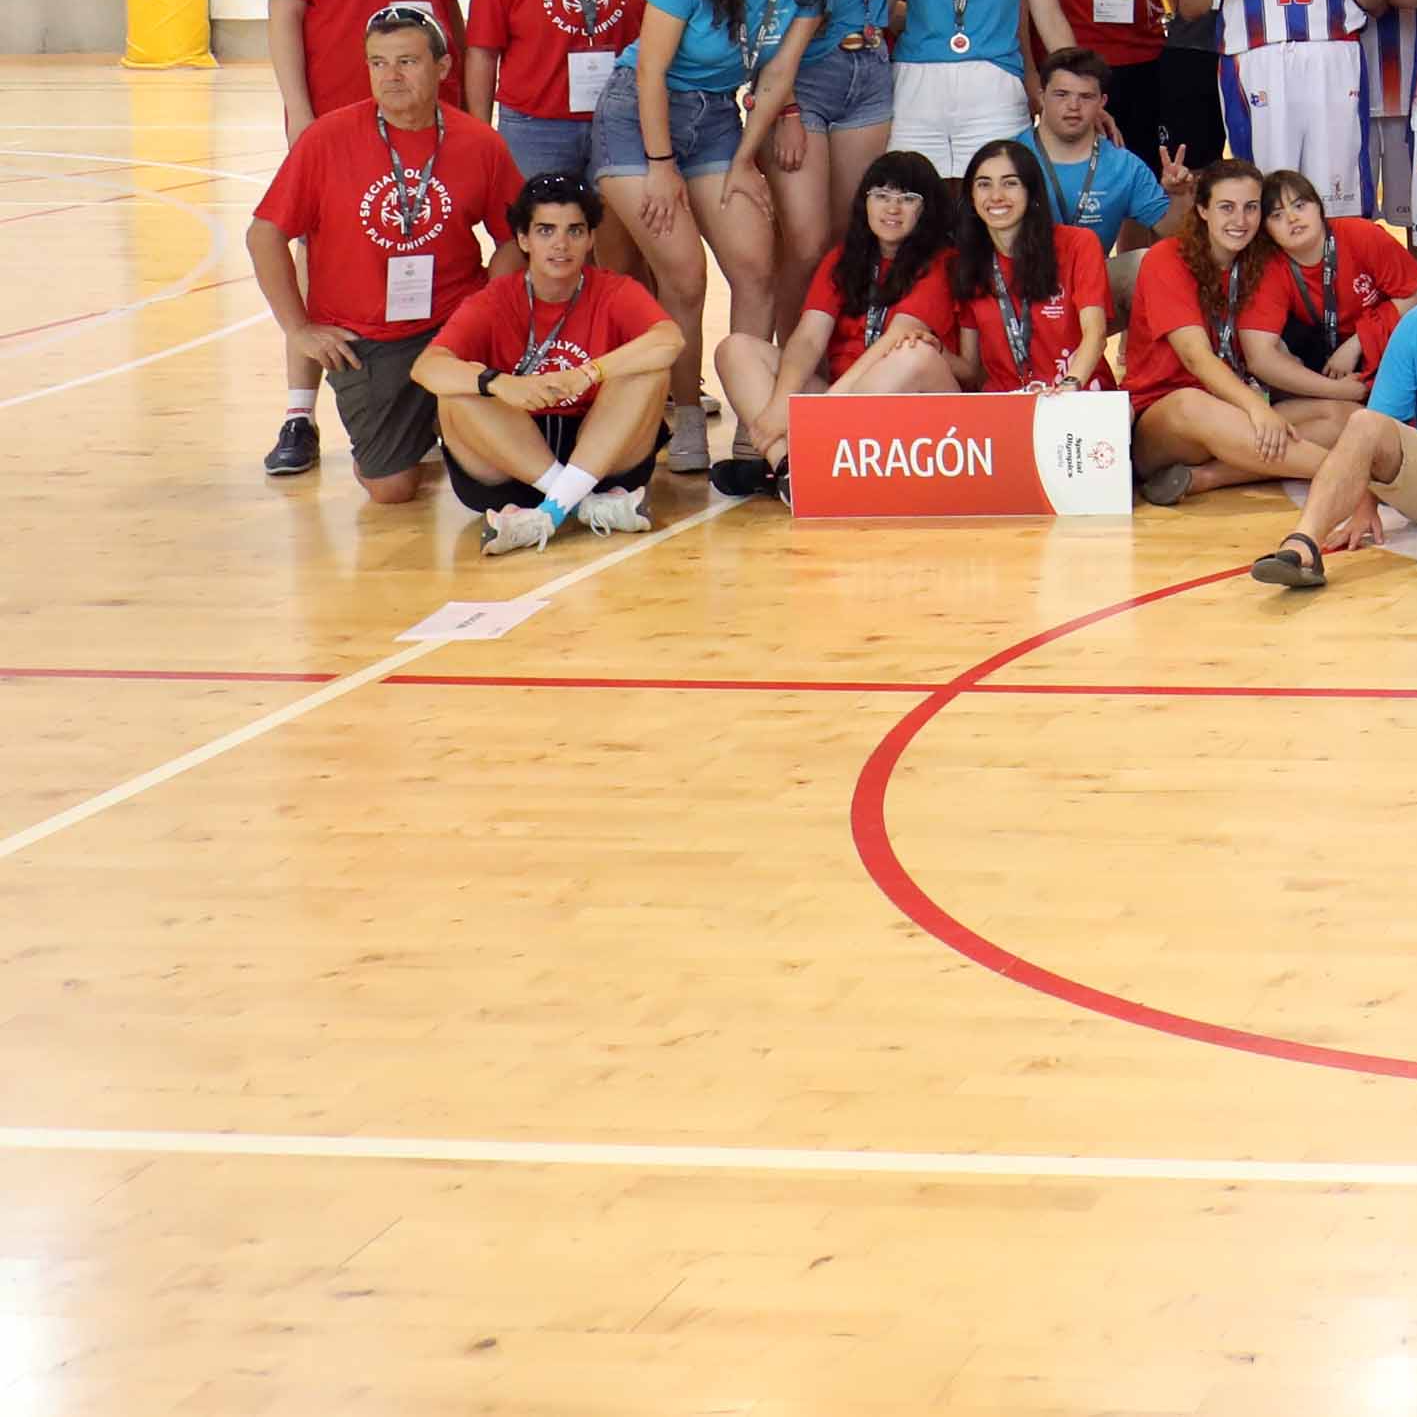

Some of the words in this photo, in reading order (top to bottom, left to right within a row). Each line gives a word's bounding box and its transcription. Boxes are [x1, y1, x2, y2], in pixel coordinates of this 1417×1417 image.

[552, 16, 578, 33] PLAY
[365, 228, 393, 248] PLAY
[397, 223, 443, 251] UNIFIED
[832, 426, 993, 478] ARAGÓN
